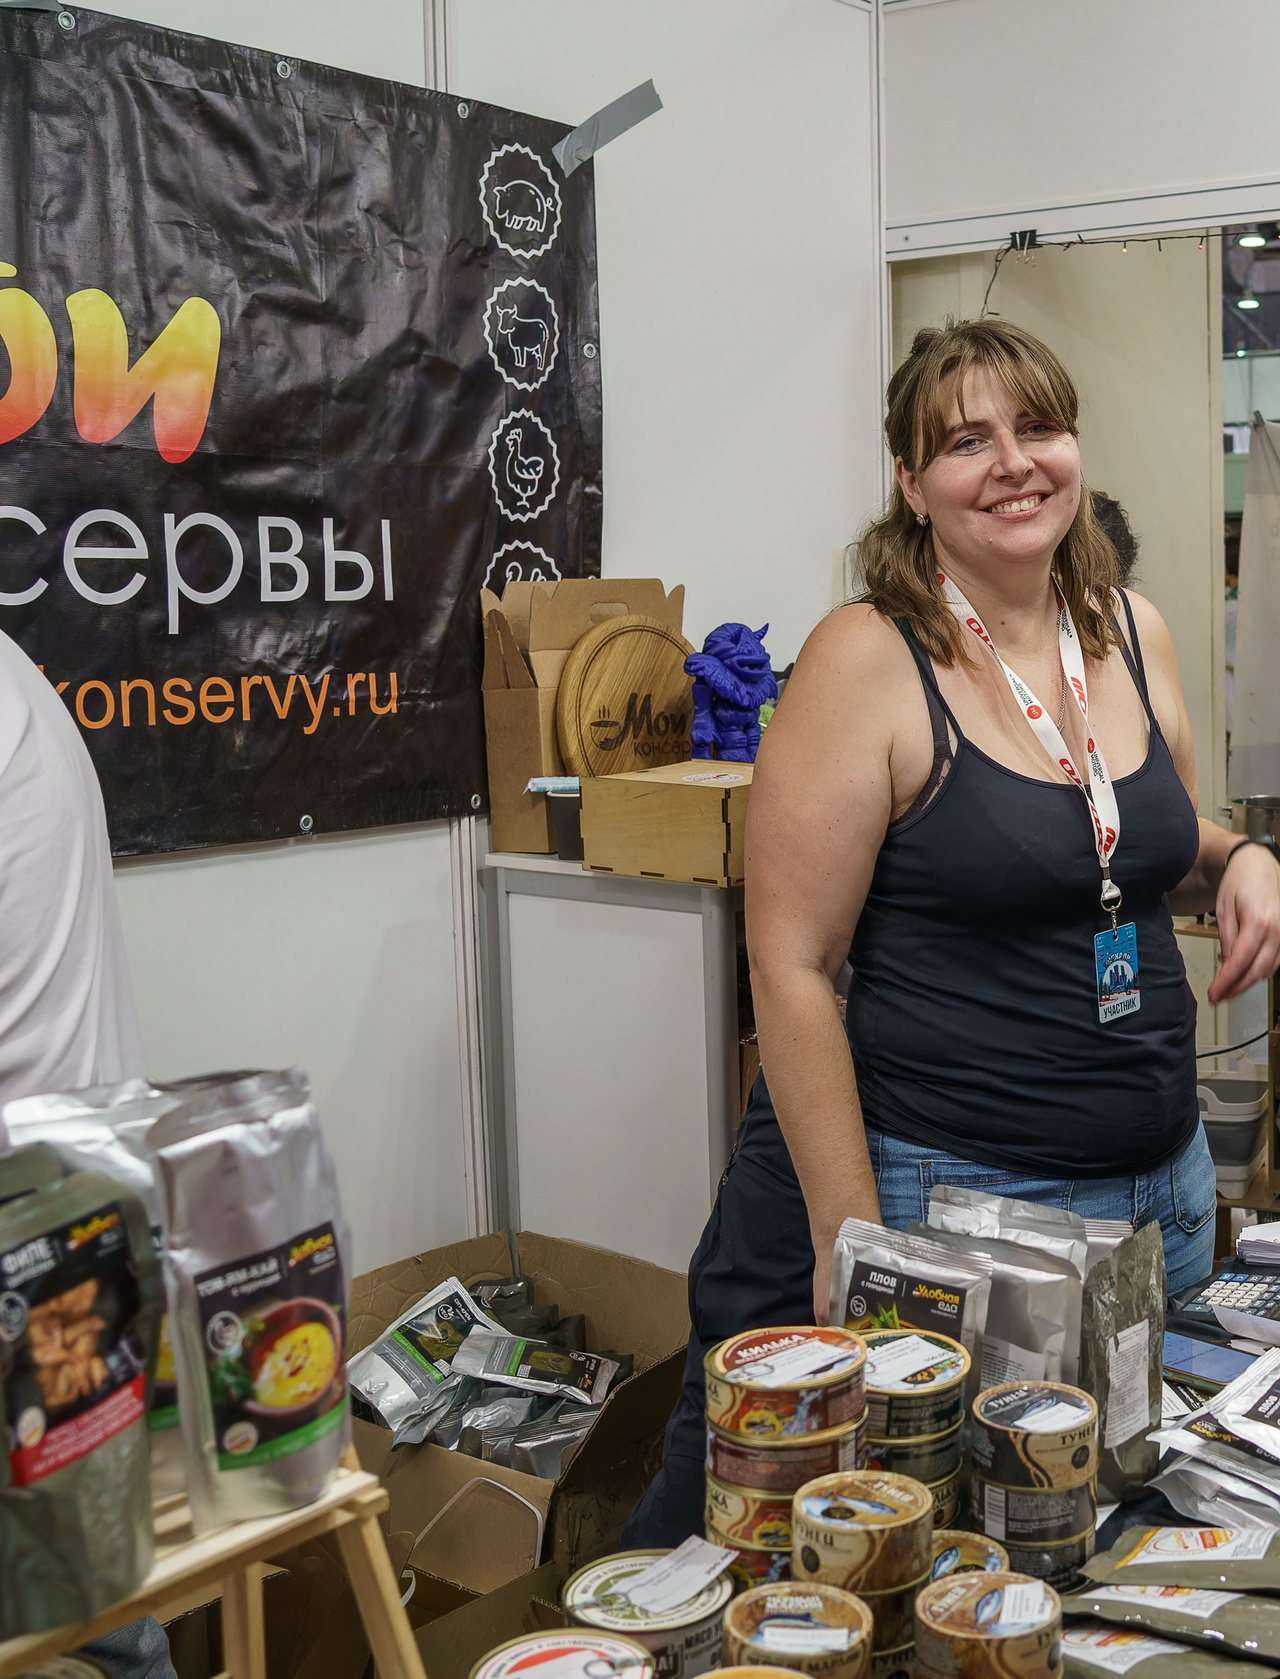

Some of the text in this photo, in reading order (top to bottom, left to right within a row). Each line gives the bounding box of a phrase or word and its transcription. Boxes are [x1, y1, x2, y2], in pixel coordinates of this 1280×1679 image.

[1103, 996, 1137, 1019] УЧАСТНИК
[865, 1281, 895, 1295] говядиной
[869, 1271, 898, 1287] ПЛОВ
[917, 1284, 960, 1305] Удобная
[937, 1301, 958, 1313] еда
[736, 1334, 807, 1359] КИЛЬКА
[987, 1388, 1029, 1408] ТУНЕЦ
[1258, 1395, 1278, 1413] ПЛОВ
